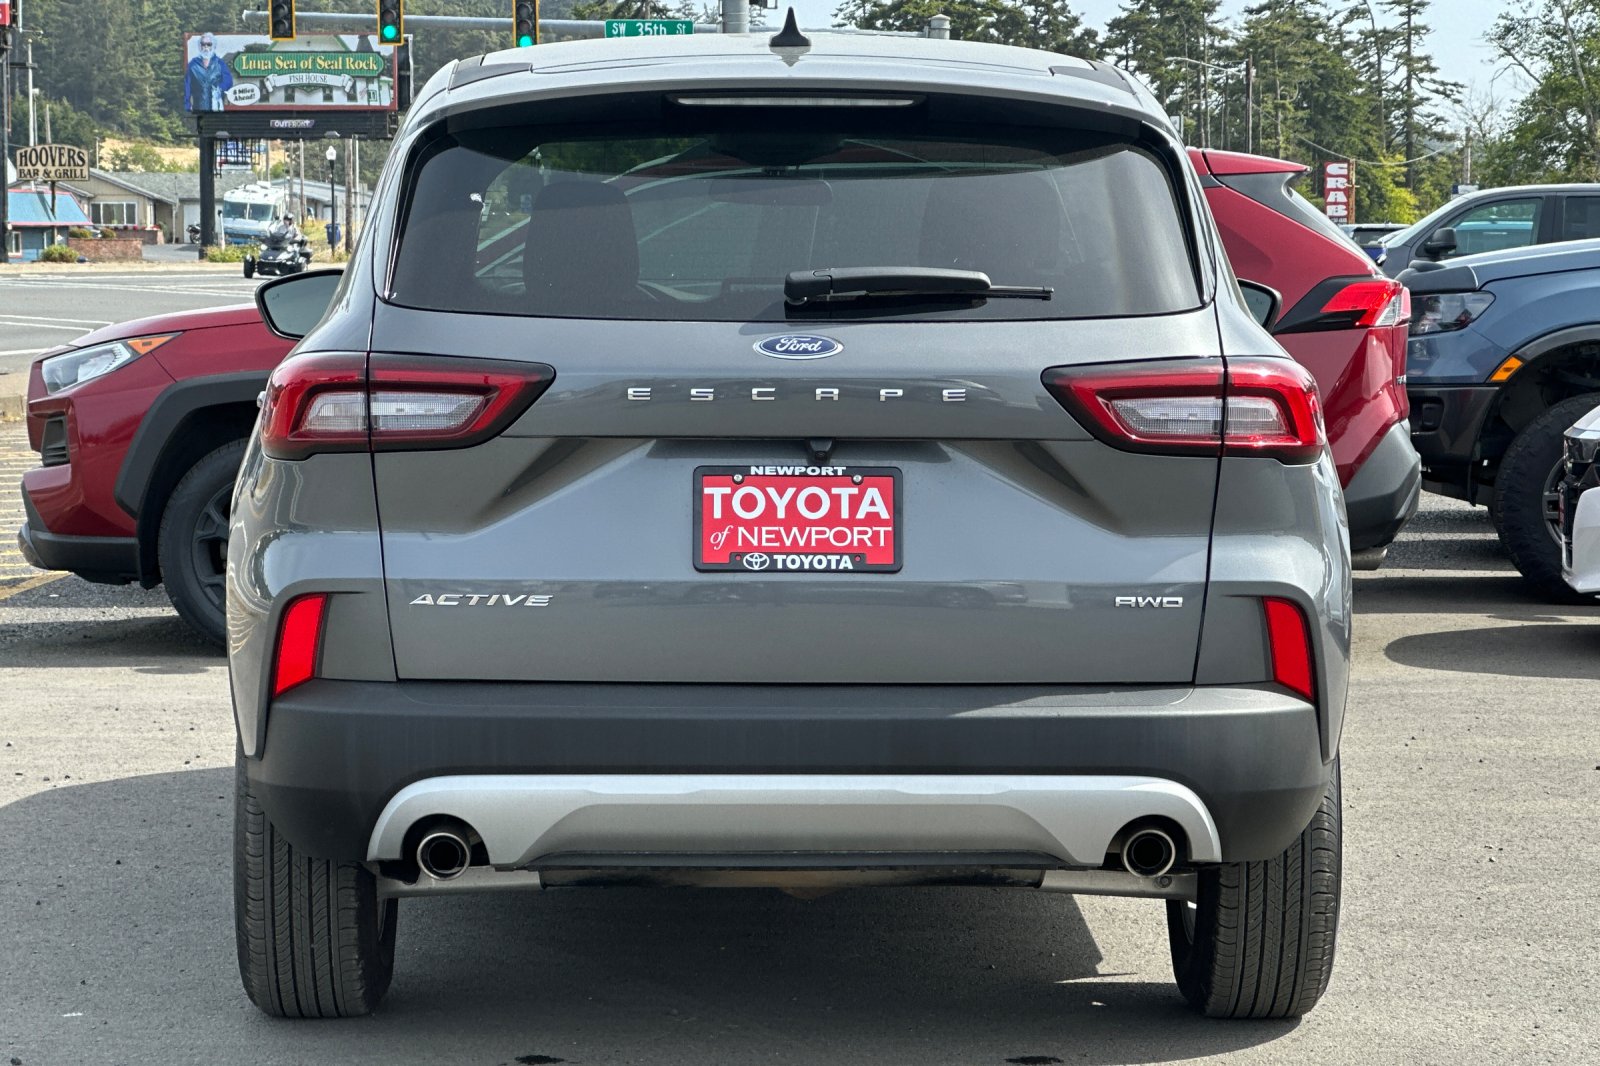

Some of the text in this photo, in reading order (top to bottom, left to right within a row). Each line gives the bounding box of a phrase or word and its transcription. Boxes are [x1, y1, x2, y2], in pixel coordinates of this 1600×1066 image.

[612, 22, 686, 36] SW 35th St
[241, 55, 378, 70] Luna Sea of Seal Rock
[289, 75, 328, 83] FISH HOUSE
[274, 119, 311, 128] OUTFRONT
[19, 146, 86, 167] HOOVERS
[19, 168, 87, 179] BAR & GRILL
[1326, 163, 1348, 216] CRAB
[775, 335, 822, 352] Ford
[627, 387, 967, 402] ESCAPE
[750, 466, 847, 476] NEWPORT
[703, 486, 891, 520] TOYOTA
[710, 525, 892, 550] of NEWPORT
[773, 554, 854, 570] TOYOTA
[408, 593, 554, 607] ACTIVE
[1115, 596, 1184, 608] AWD
